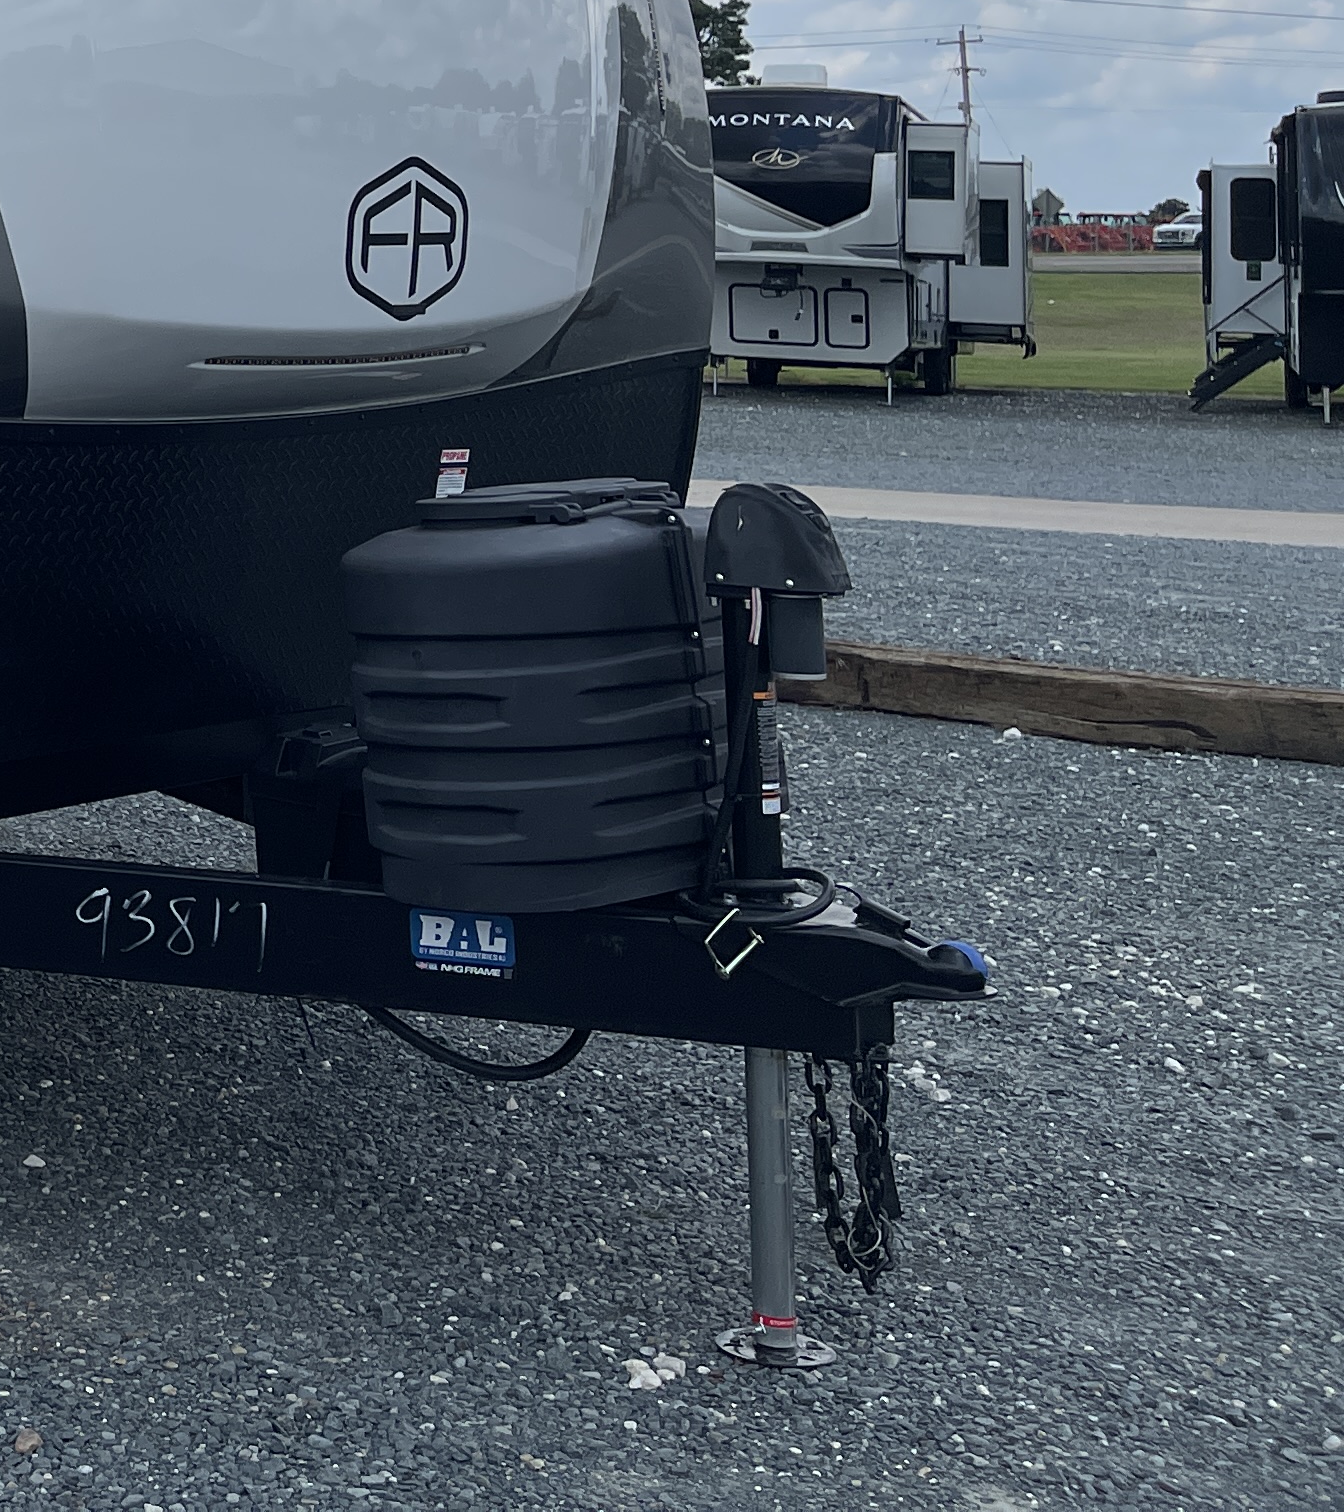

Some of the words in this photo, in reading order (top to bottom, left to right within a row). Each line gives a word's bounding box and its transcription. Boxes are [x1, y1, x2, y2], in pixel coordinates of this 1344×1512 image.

[708, 113, 855, 131] MONTANA
[75, 887, 267, 973] 93817
[419, 914, 507, 954] BAL
[464, 966, 501, 978] FRAME
